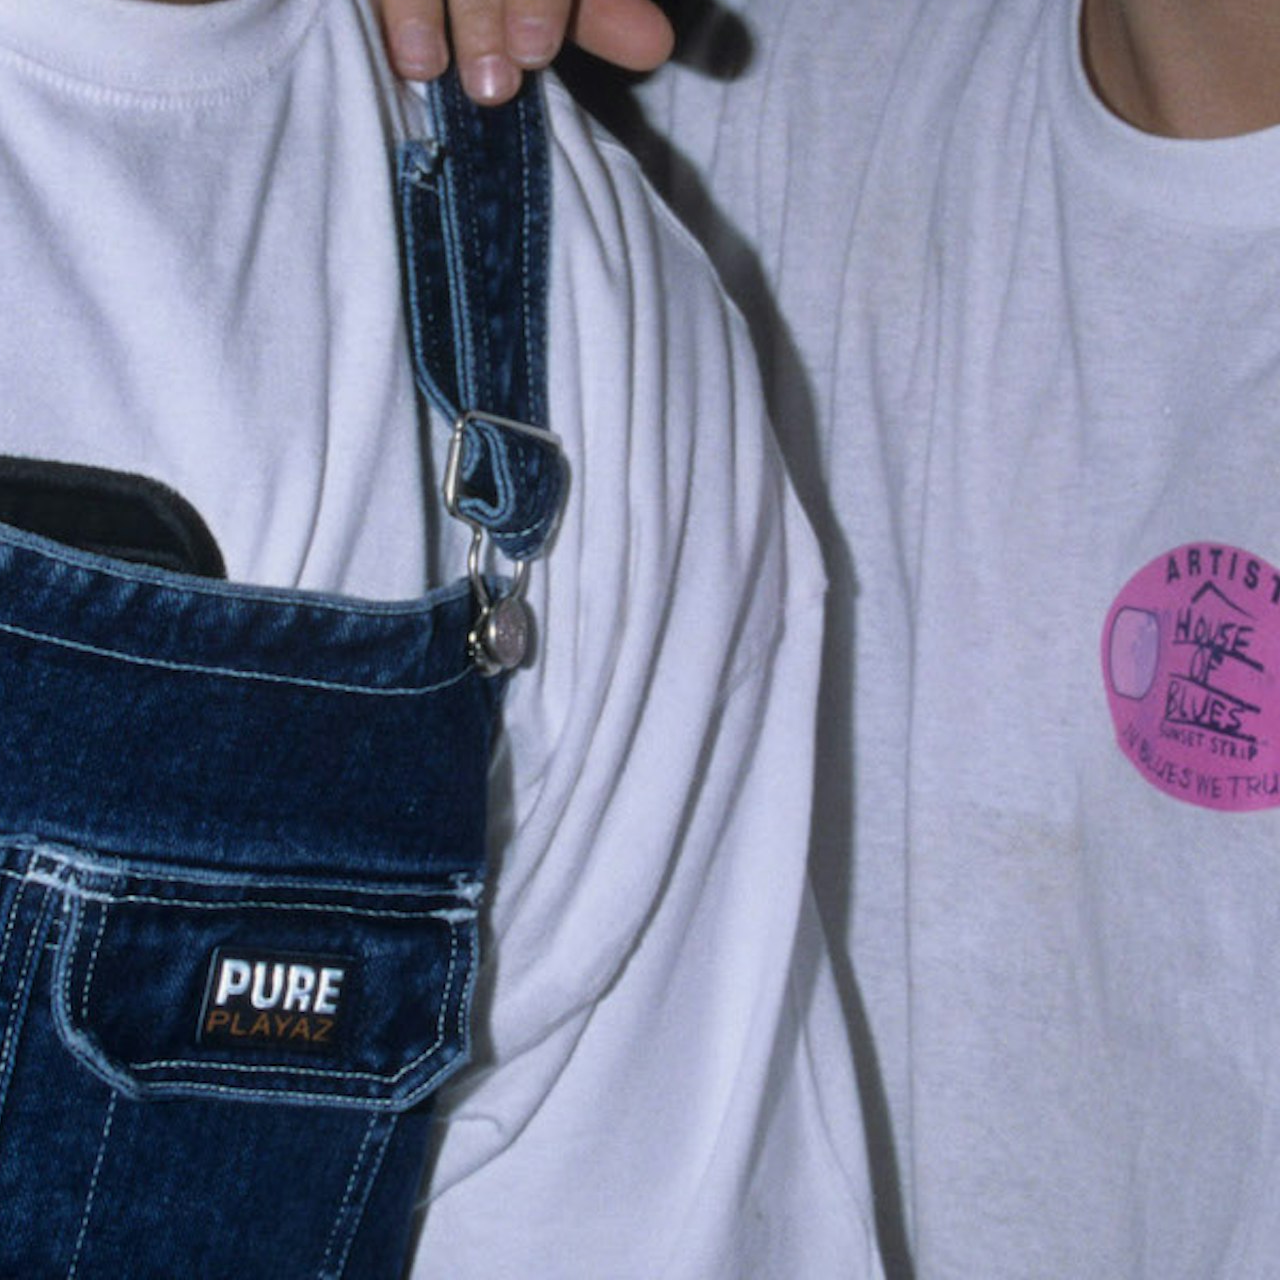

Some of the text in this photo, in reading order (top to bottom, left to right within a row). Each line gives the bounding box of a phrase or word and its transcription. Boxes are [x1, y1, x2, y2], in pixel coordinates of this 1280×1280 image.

[1175, 607, 1254, 652] HOUSE
[1166, 680, 1246, 734] BLUES
[1211, 734, 1257, 761] STRIP
[215, 958, 345, 1015] PURE
[206, 1010, 334, 1042] PLAYAZ
